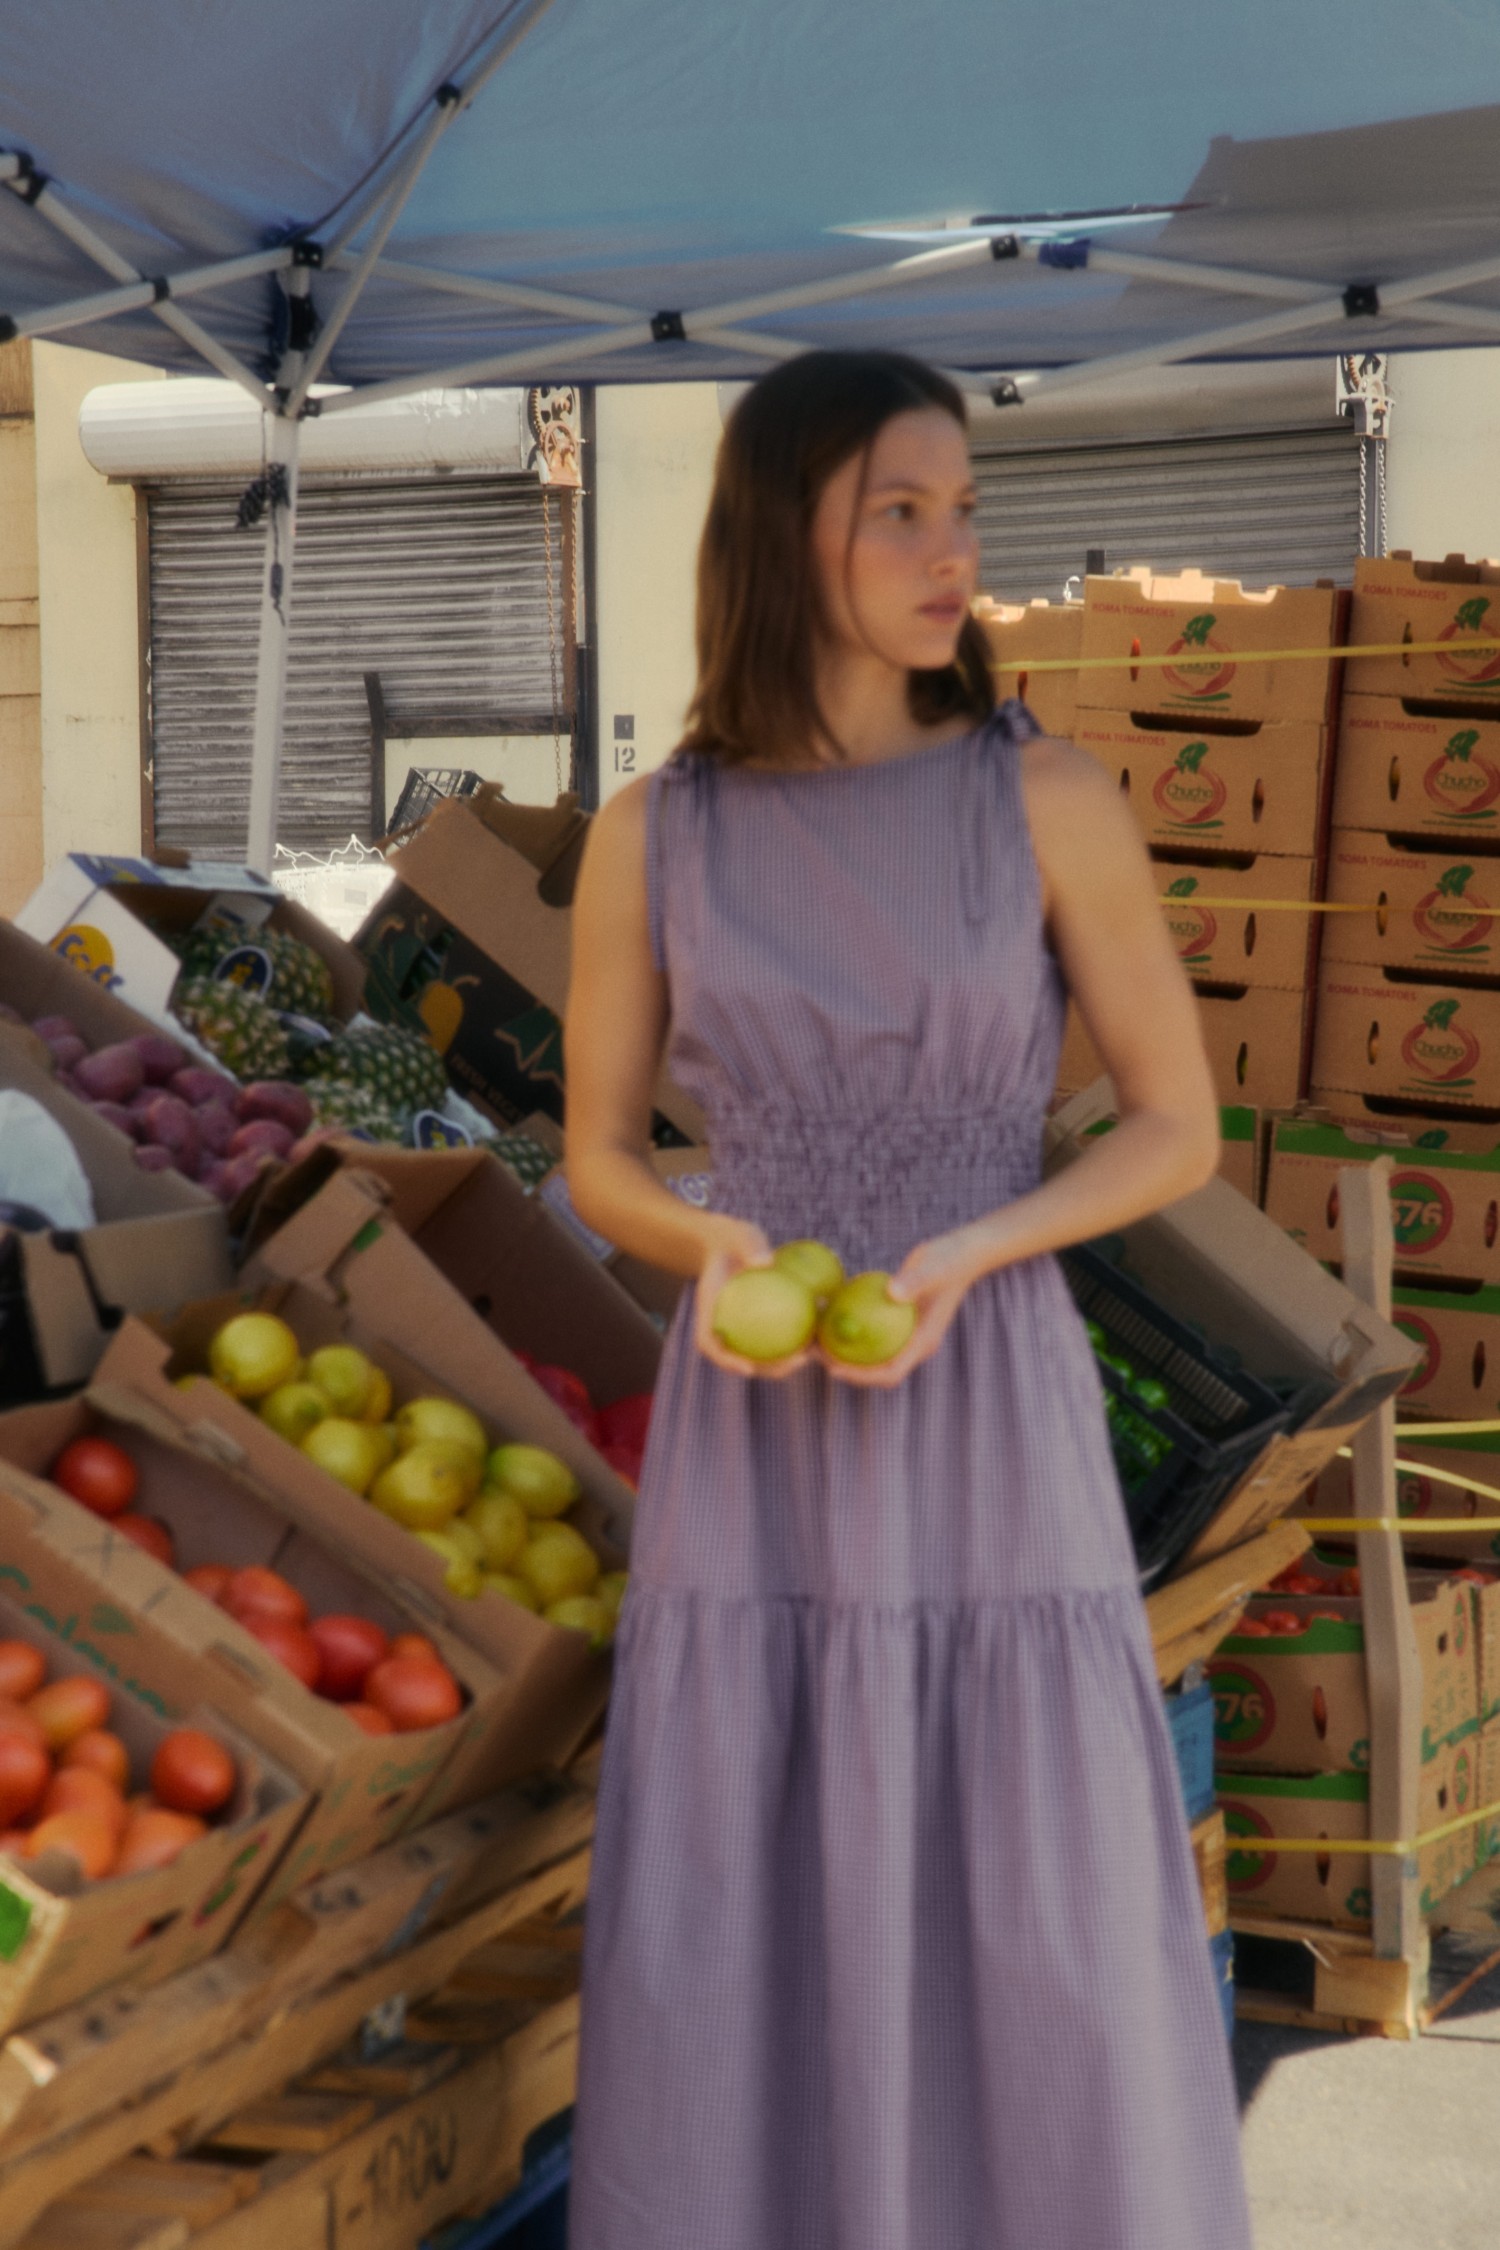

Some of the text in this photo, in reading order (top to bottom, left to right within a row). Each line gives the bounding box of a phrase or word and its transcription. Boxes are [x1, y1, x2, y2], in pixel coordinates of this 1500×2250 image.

[1082, 731, 1166, 746] ROMA TOMATOES
[614, 746, 635, 772] 12
[1166, 783, 1214, 799] Chucho
